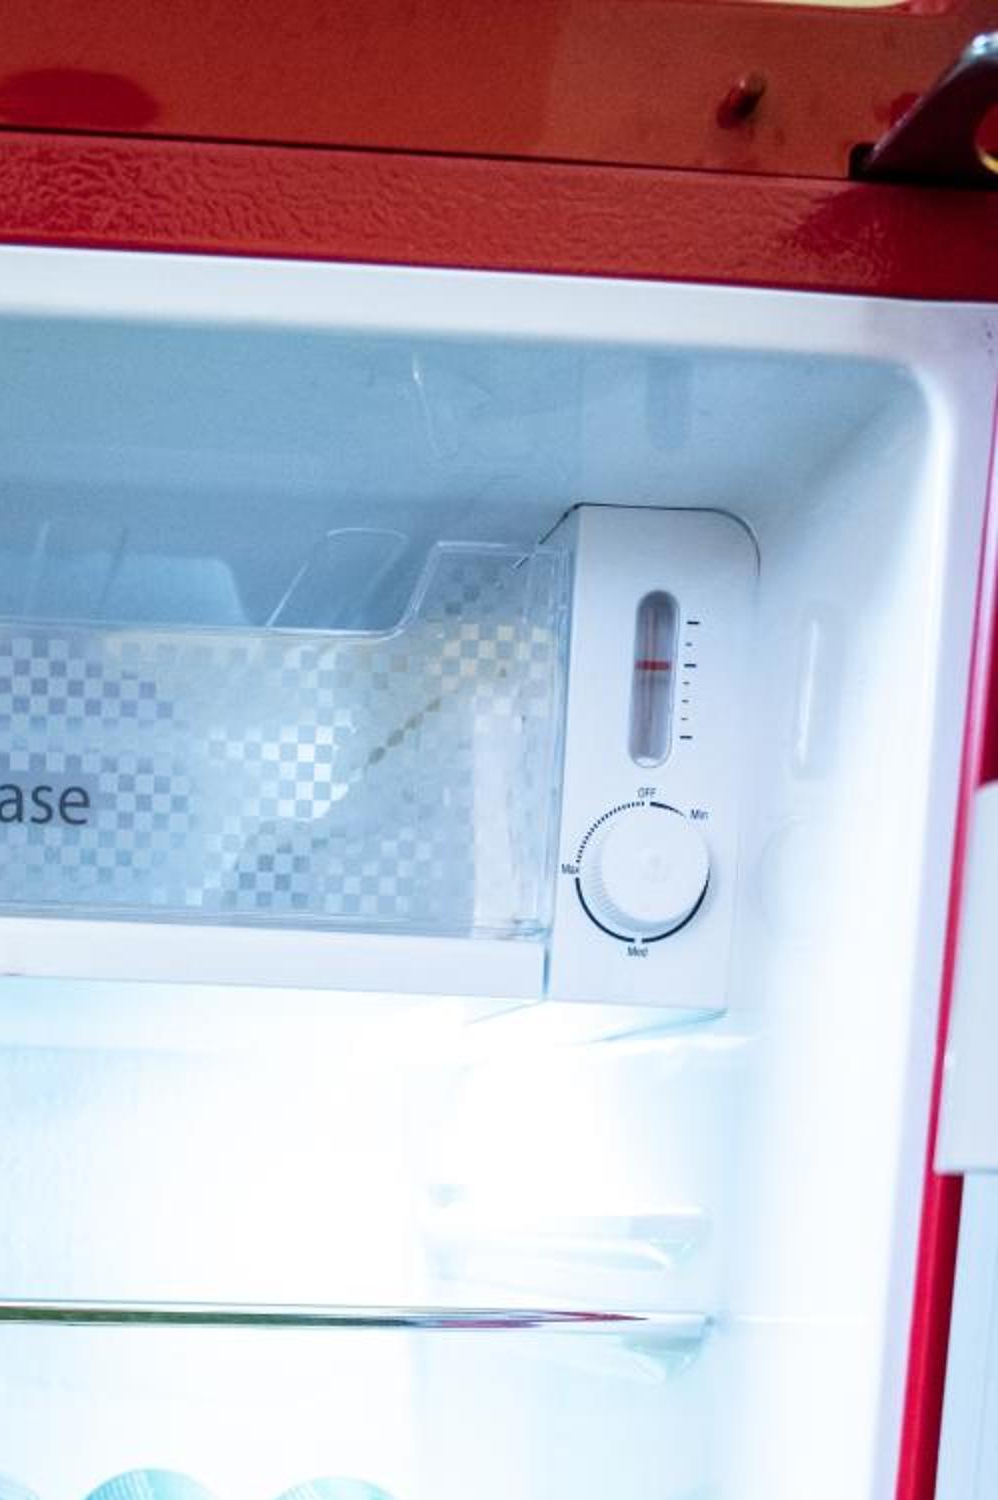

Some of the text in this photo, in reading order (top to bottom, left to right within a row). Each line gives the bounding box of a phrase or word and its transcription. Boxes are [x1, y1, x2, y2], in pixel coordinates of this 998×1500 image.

[637, 787, 657, 799] OFF
[690, 809, 708, 821] Min
[561, 863, 580, 875] Max
[627, 946, 649, 958] Med
